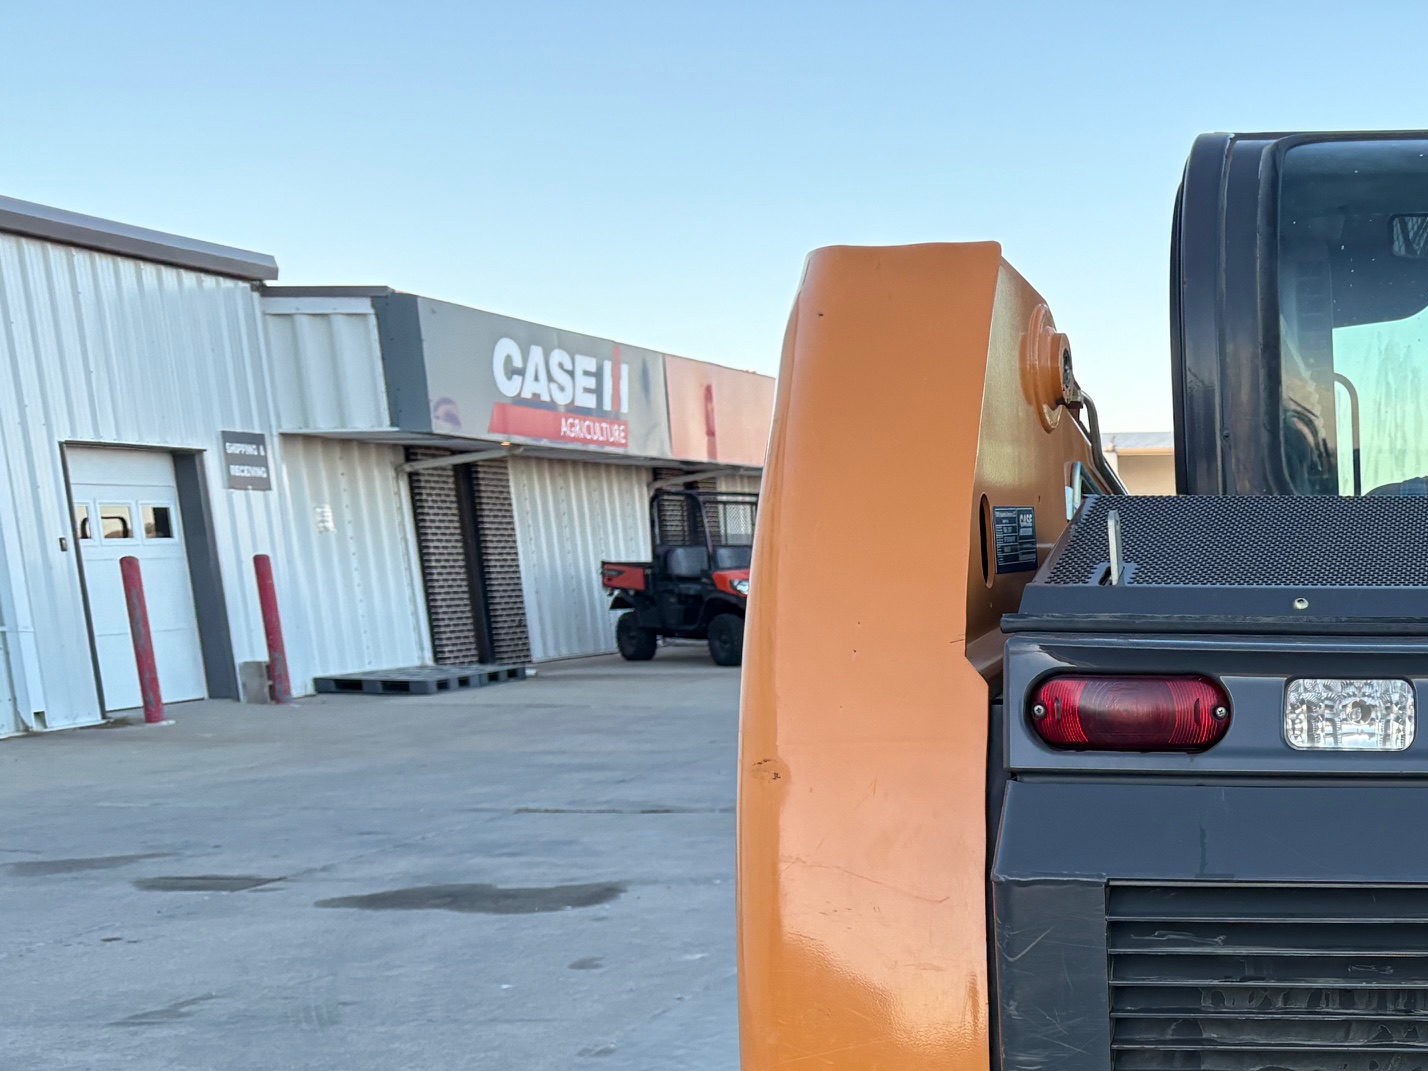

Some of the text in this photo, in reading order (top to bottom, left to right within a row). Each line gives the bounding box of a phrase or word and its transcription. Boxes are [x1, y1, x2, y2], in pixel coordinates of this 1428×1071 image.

[492, 337, 597, 408] CASE
[560, 417, 627, 444] AGRICULTURE
[229, 464, 268, 478] RECEIVING
